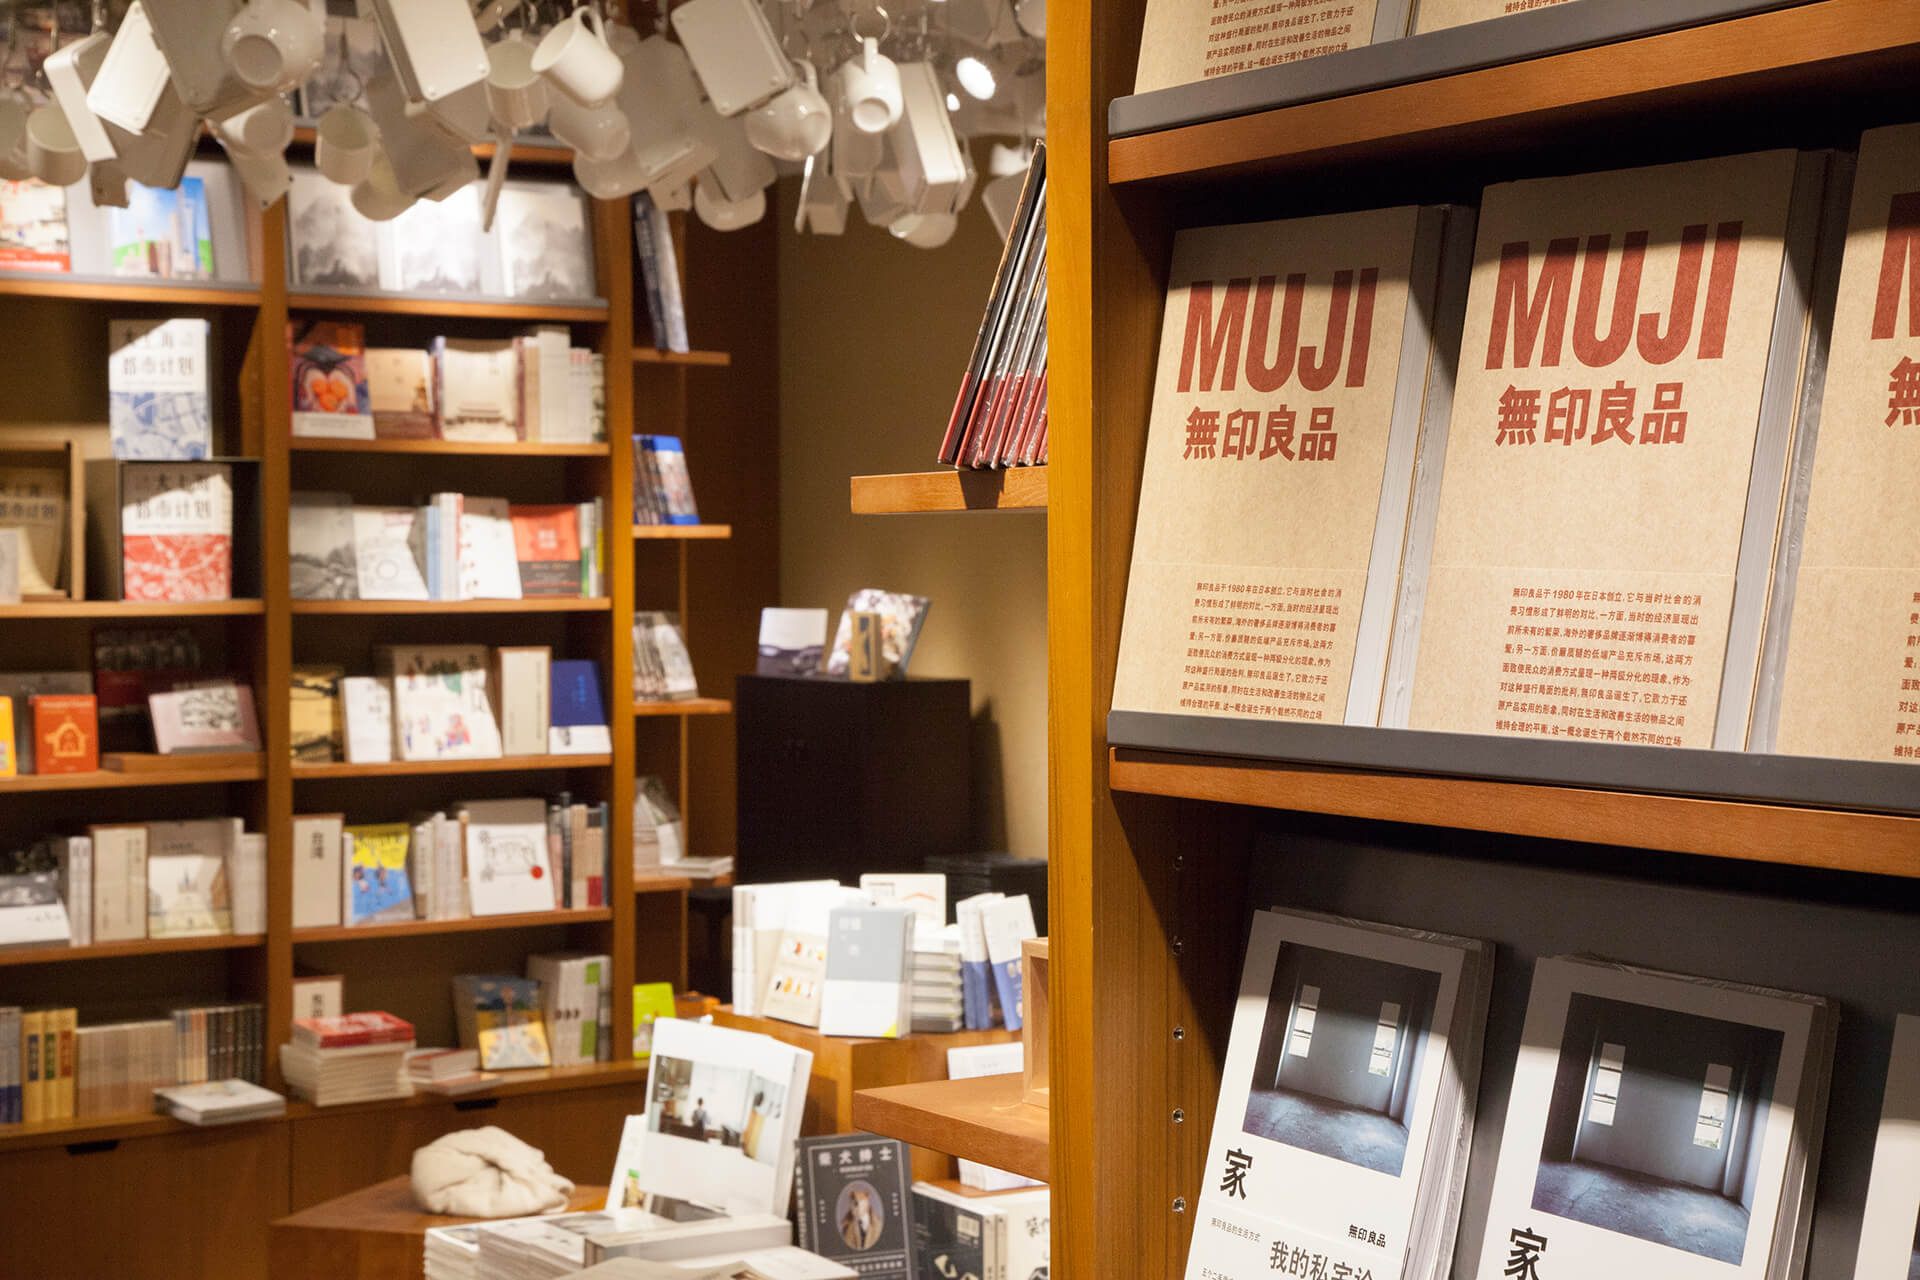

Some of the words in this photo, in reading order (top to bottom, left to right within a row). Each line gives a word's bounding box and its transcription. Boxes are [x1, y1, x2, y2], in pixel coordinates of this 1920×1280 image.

[1485, 221, 1743, 369] MUJI
[1177, 267, 1379, 392] MUJI
[1183, 404, 1337, 461] 無印良品
[1495, 380, 1688, 446] 無印良品
[1219, 1148, 1253, 1200] 家
[1348, 1224, 1386, 1248] 無印良品
[1504, 1227, 1547, 1280] 家
